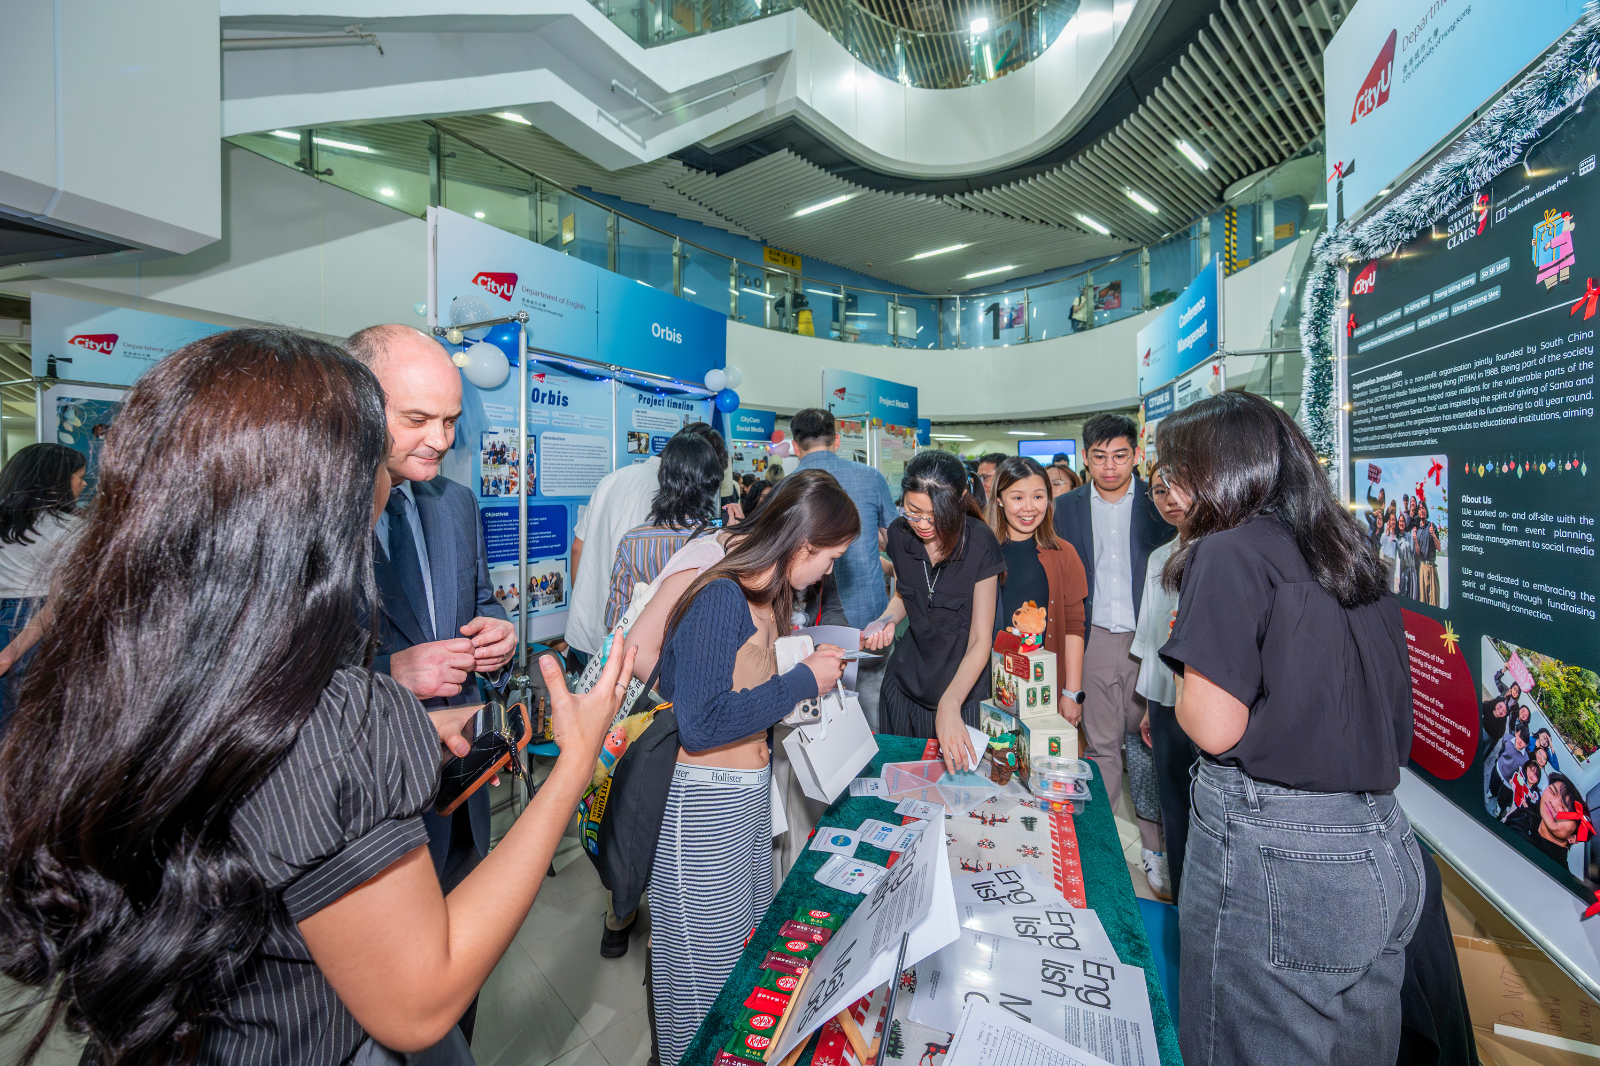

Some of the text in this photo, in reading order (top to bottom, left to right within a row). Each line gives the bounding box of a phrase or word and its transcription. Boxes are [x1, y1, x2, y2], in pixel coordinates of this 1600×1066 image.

[1402, 0, 1448, 52] Departm
[1402, 72, 1411, 83] City
[1412, 46, 1434, 73] University
[1442, 22, 1456, 41] Hong
[1456, 4, 1472, 24] Kong
[1355, 60, 1392, 120] CityU
[1508, 188, 1524, 201] presented
[1508, 176, 1568, 214] South China Morning Post
[1447, 224, 1476, 250] CLAUS
[1448, 211, 1476, 237] SANTA
[477, 276, 514, 296] CityU
[1354, 271, 1376, 294] CityU
[1482, 270, 1488, 278] So
[522, 285, 558, 302] Department
[566, 298, 586, 310] English
[984, 302, 1000, 340] 1
[1179, 296, 1206, 329] Conference
[74, 337, 114, 351] CityU
[652, 322, 682, 344] Orbis
[1177, 319, 1207, 354] Management
[123, 342, 165, 353] Department
[1439, 330, 1594, 377] organisation jointly founded by South China
[1427, 360, 1594, 401] helped millions for the vulnerable parts of the
[1430, 346, 1594, 390] Hong Kong in Being part of the society
[531, 387, 569, 407] Orbis
[638, 394, 694, 411] Project timeline
[879, 396, 909, 408] Project Reach
[1450, 374, 1594, 408] inspired by the spirit of giving of Santa and
[1453, 409, 1478, 419] extended
[1487, 402, 1524, 414] fundraising
[1525, 401, 1532, 409] to
[1534, 398, 1544, 407] all
[1546, 396, 1564, 407] year
[1566, 390, 1594, 403] round.
[1442, 424, 1457, 433] sports
[1458, 422, 1472, 430] clubs
[1480, 416, 1518, 428] educational
[1519, 413, 1561, 423] institutions,
[1563, 407, 1594, 417] aiming
[1462, 495, 1492, 504] About Us
[1474, 509, 1496, 518] worked
[1512, 512, 1526, 520] and
[1528, 512, 1554, 522] off-site
[1557, 515, 1576, 524] with
[1580, 516, 1594, 525] the
[1462, 520, 1595, 542] OSC team from event planning,
[1462, 532, 1484, 542] website
[1486, 536, 1530, 548] management
[1541, 542, 1565, 553] social
[1566, 546, 1595, 556] media
[1462, 544, 1484, 555] posting.
[1462, 567, 1596, 602] We are dedicated to embracing the
[1462, 580, 1596, 619] spirit of giving through fundraising
[1462, 591, 1553, 621] and community connection.
[1424, 662, 1432, 670] the
[1433, 666, 1452, 680] general
[1436, 656, 1444, 665] the
[1421, 672, 1439, 684] and the
[1436, 700, 1444, 709] the
[1424, 714, 1434, 726] help
[1431, 708, 1470, 737] the community
[1426, 738, 1465, 769] and fundraising
[711, 772, 742, 783] Hollister
[597, 780, 608, 819] CITYUHK
[994, 869, 1036, 904] Eng
[1046, 910, 1081, 950] Eng
[1041, 959, 1075, 997] lish
[1075, 959, 1115, 1009] Eng
[1500, 966, 1526, 1000] NOT
[749, 1036, 769, 1047] KitKat
